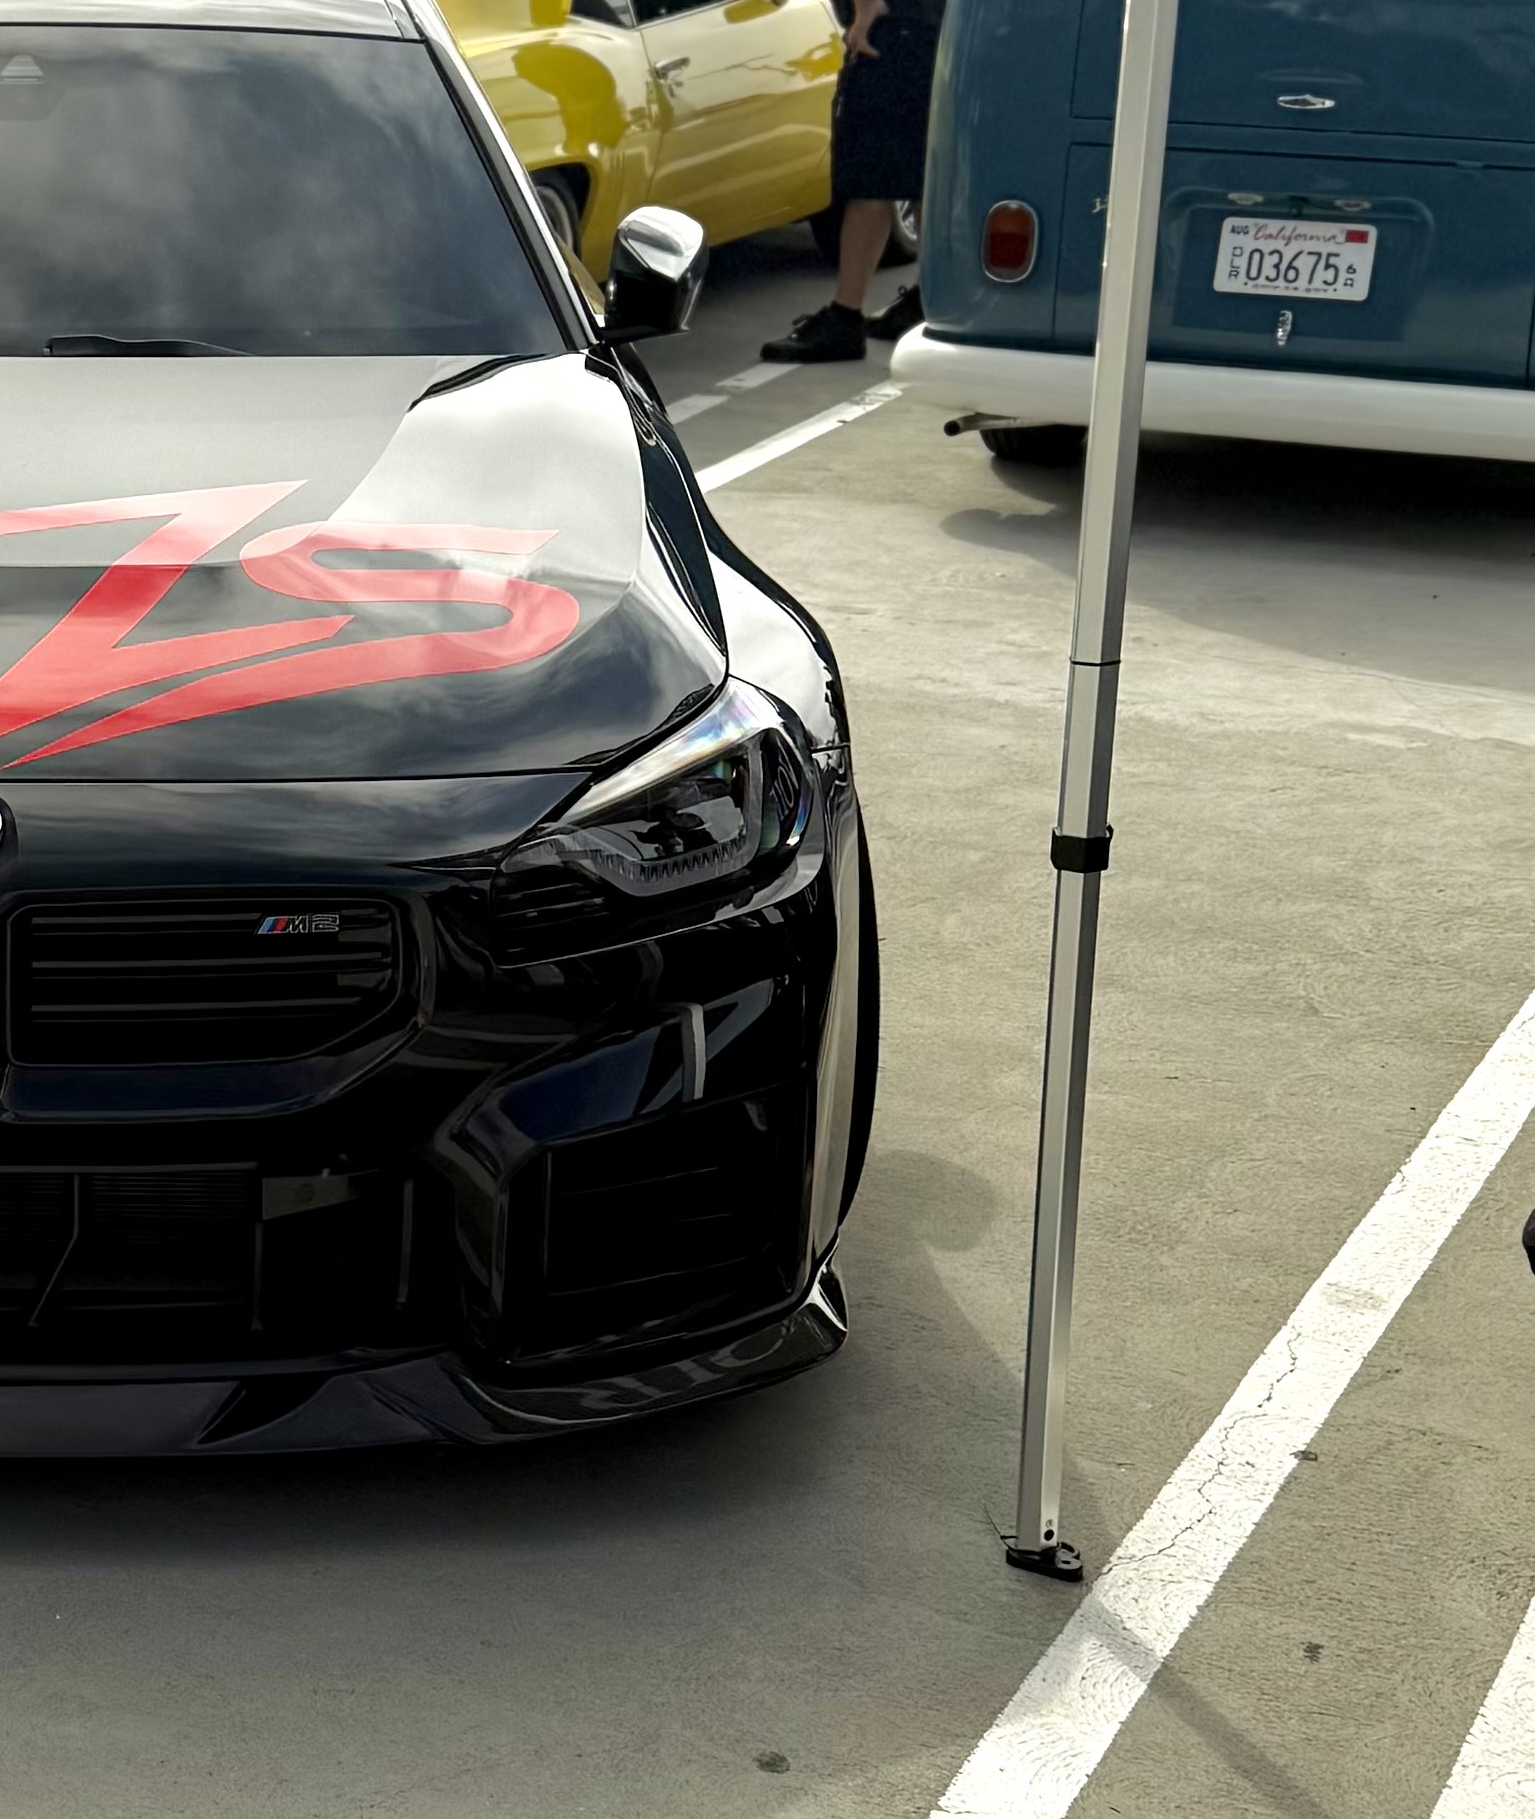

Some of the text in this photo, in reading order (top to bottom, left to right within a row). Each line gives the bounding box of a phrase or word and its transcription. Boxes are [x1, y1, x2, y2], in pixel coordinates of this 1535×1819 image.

[1230, 222, 1345, 248] AUG California
[1228, 246, 1244, 280] DLR
[1245, 248, 1341, 287] 03675
[278, 914, 340, 933] M2
